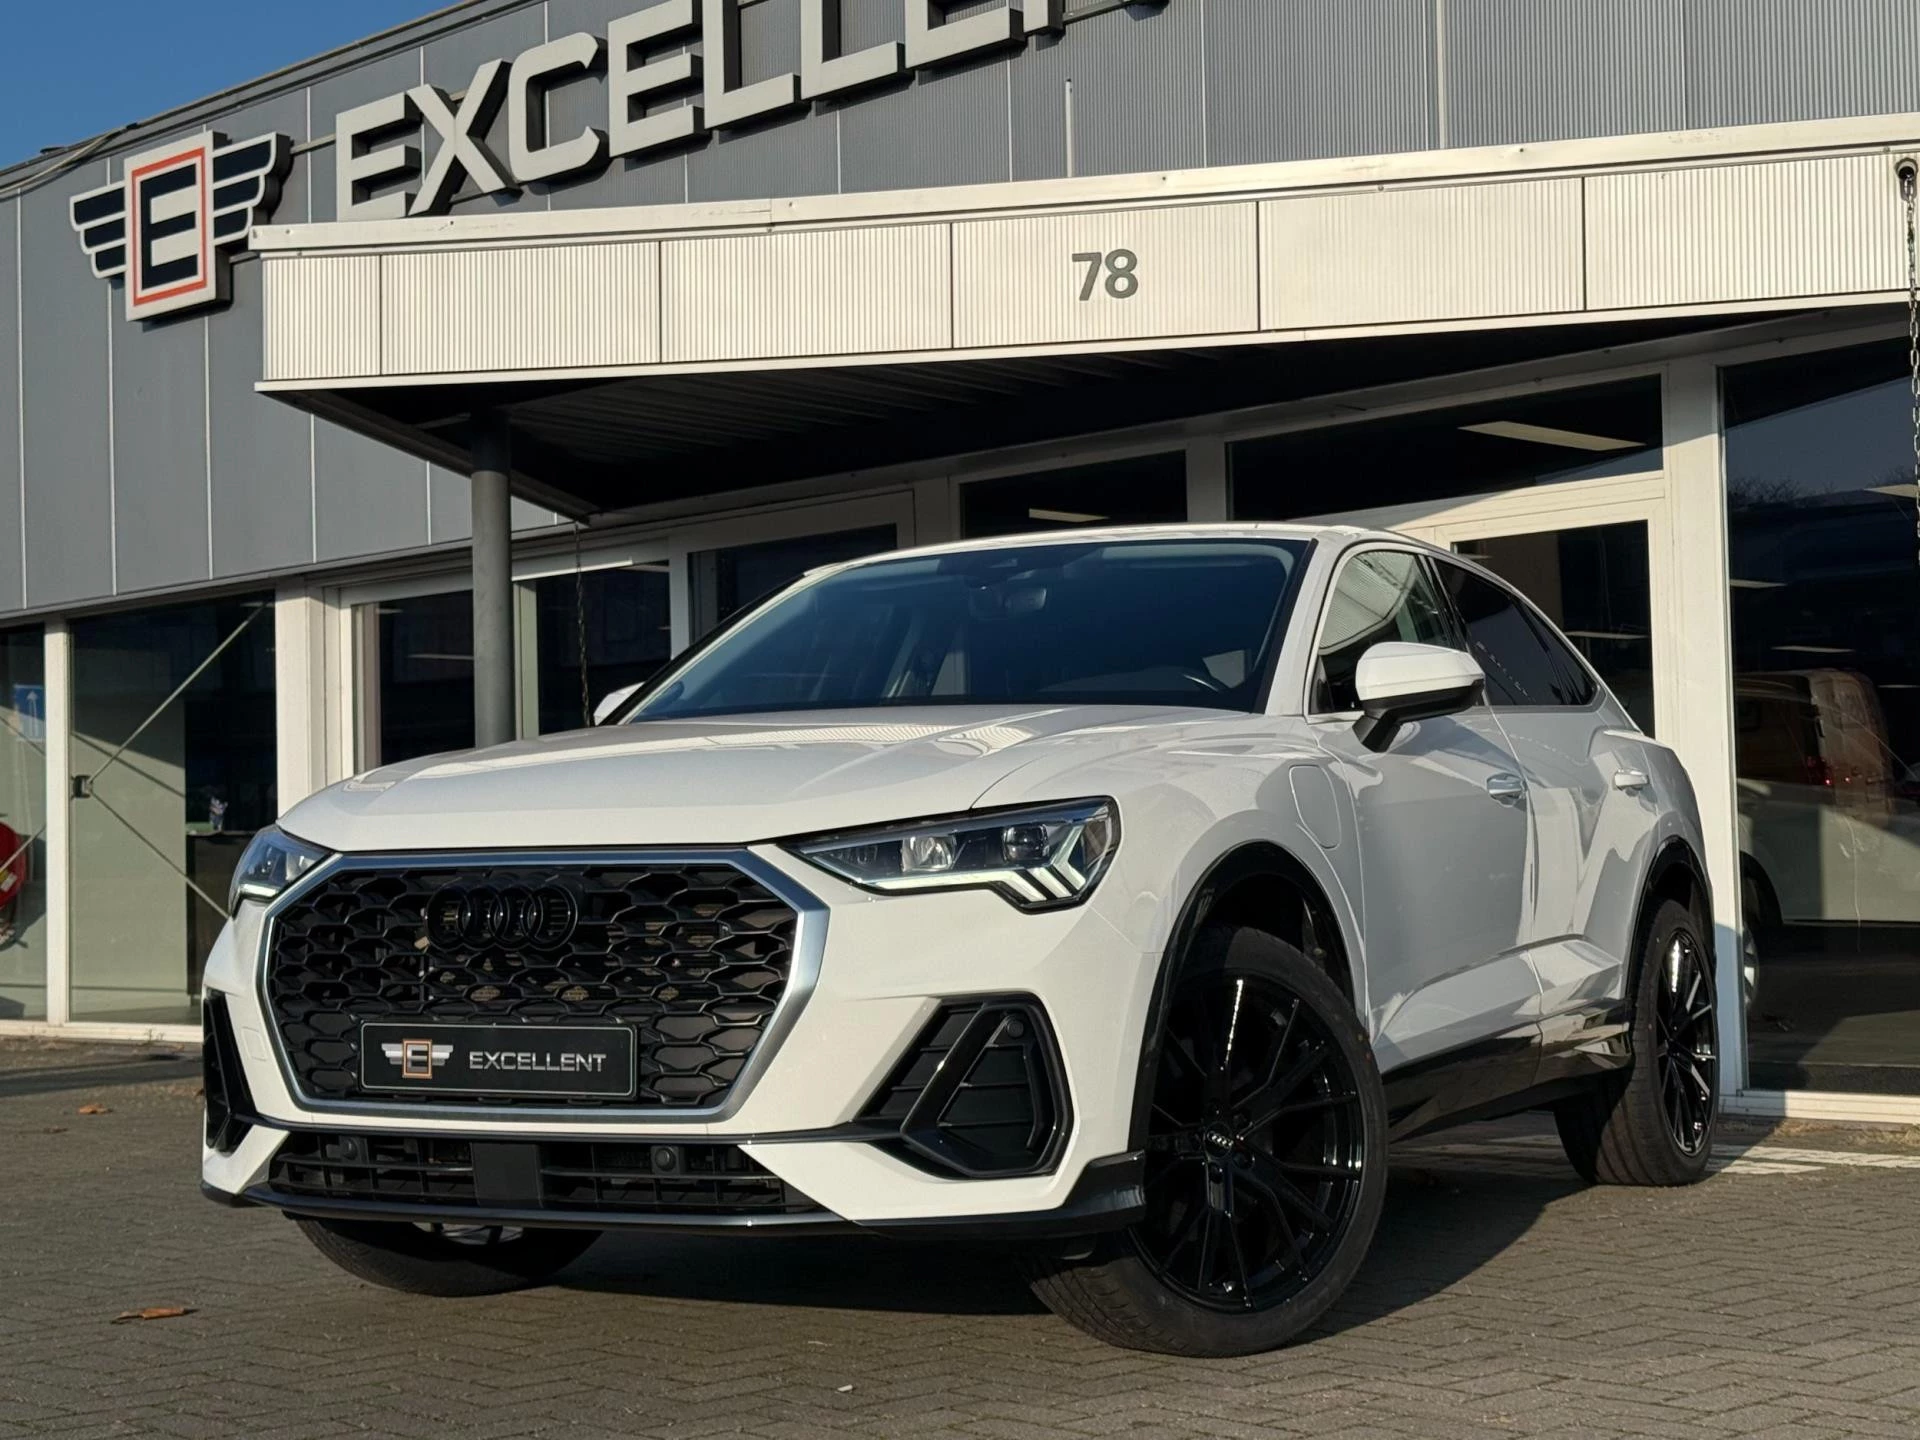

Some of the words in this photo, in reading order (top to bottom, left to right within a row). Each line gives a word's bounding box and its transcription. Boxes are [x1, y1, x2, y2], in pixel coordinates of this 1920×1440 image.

[335, 0, 1064, 221] EXCELL
[140, 163, 198, 289] E
[1072, 248, 1139, 301] 78
[469, 1050, 607, 1072] EXCELLENT
